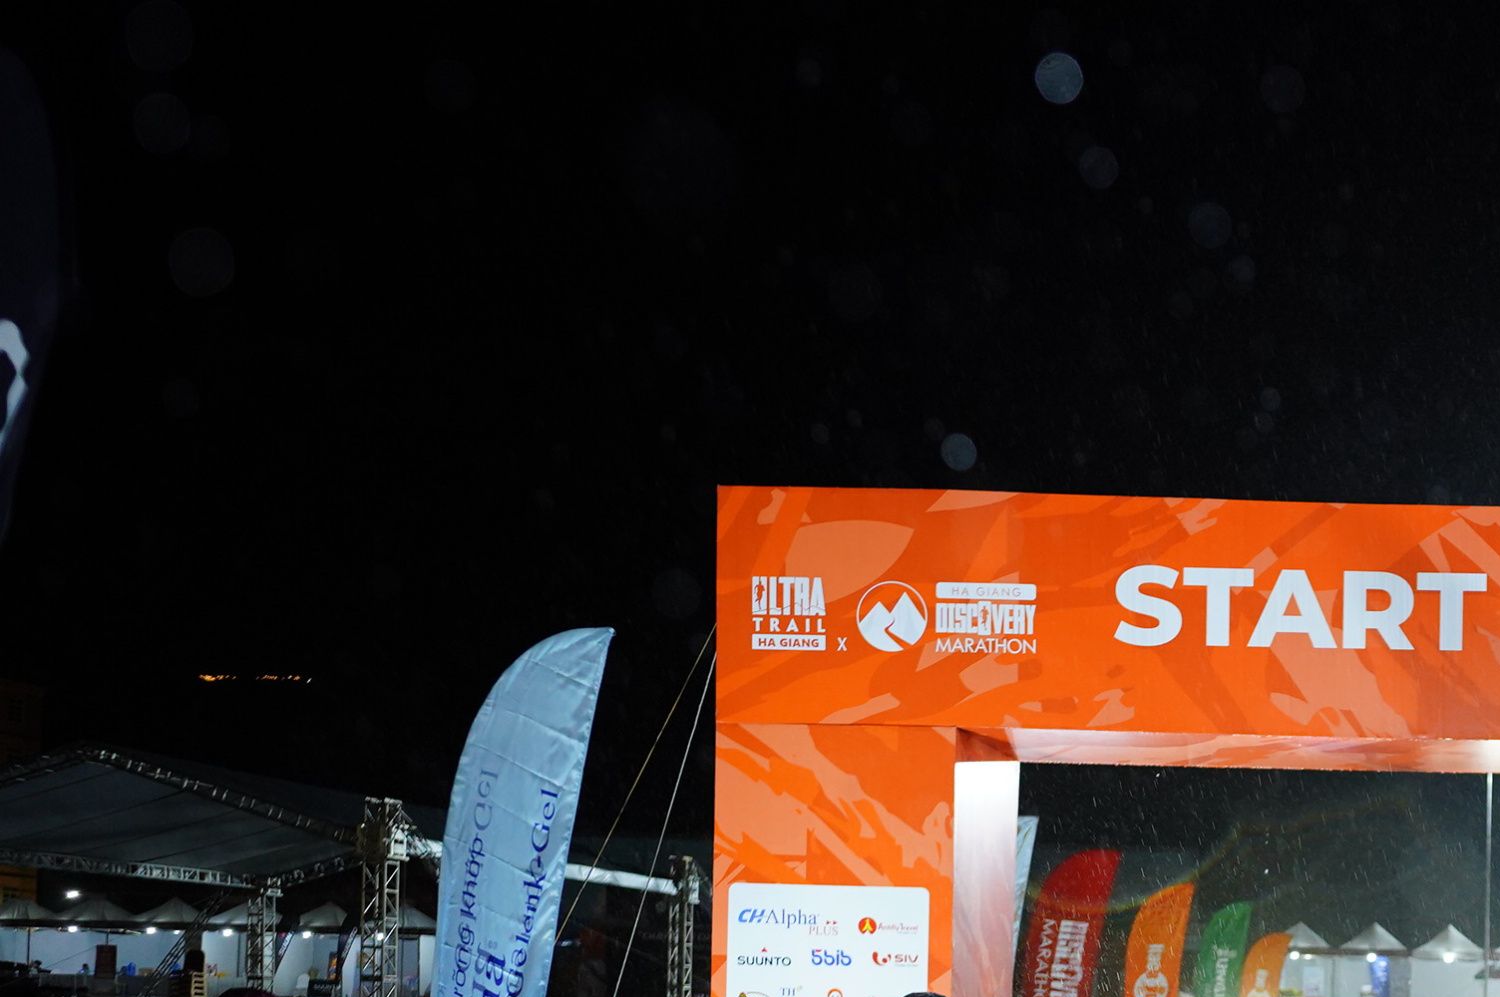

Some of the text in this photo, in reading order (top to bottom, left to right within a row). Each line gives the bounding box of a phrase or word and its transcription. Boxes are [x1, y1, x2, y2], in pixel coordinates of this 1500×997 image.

[952, 585, 1022, 597] HA GIANG
[1114, 564, 1487, 651] START
[752, 617, 826, 633] TRAIL
[935, 601, 1037, 636] DISCOVERY
[757, 636, 820, 649] HA GIANG
[935, 637, 1037, 654] MARATHON
[808, 925, 839, 937] PLUS
[737, 949, 919, 967] SUUNTO 5bib SIV
